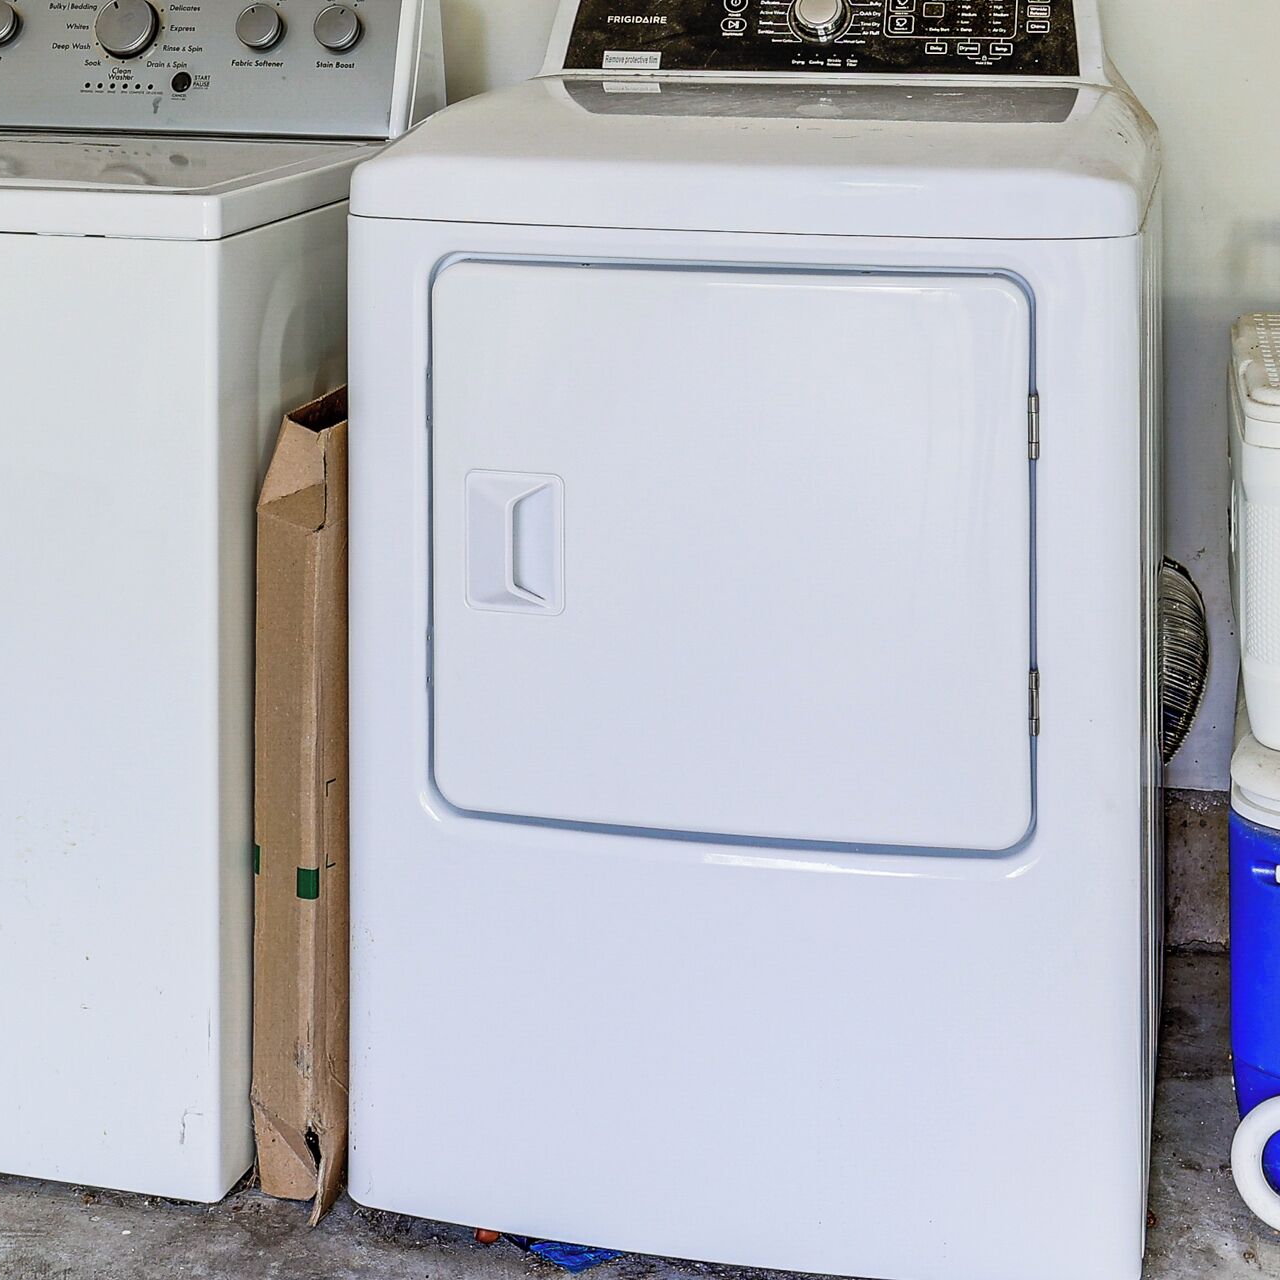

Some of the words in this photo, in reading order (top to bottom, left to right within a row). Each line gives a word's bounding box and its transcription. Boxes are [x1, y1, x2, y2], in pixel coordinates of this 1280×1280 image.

[607, 15, 668, 24] FRIGIDAIRE
[187, 45, 203, 53] Spin
[605, 55, 624, 64] Remove
[624, 55, 649, 65] protective
[649, 56, 658, 64] film
[172, 61, 188, 69] Spin
